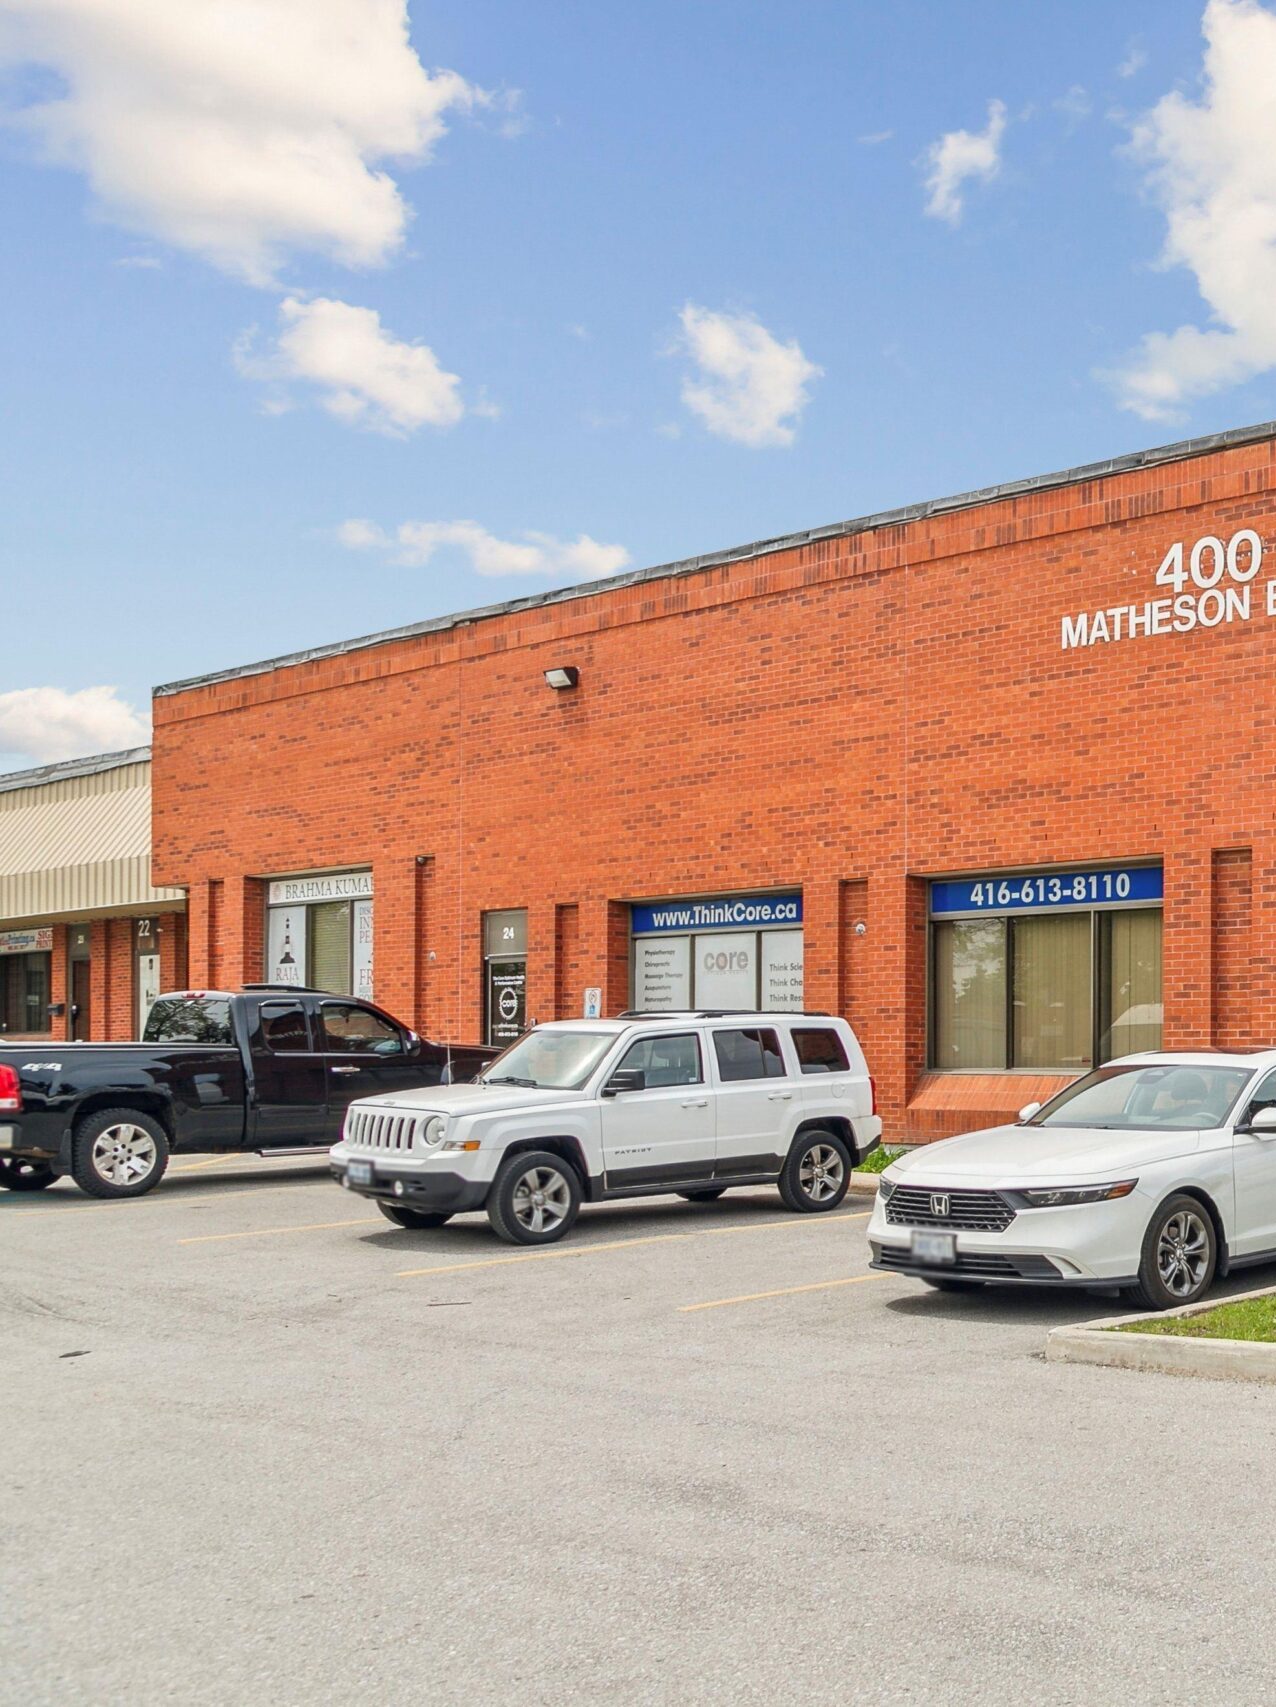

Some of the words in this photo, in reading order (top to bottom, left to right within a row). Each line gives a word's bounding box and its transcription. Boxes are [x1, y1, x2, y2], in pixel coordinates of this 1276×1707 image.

[1156, 529, 1262, 593] 400
[1061, 586, 1250, 649] MATHESON
[285, 882, 332, 899] BRAHMA
[970, 873, 1130, 906] 416-613-8110
[652, 903, 797, 927] www.ThinkCore.ca
[138, 920, 150, 936] 22
[503, 927, 514, 939] 24
[360, 930, 373, 943] PE
[704, 952, 749, 970] core
[769, 963, 788, 972] Think
[276, 967, 299, 982] RAJA
[769, 978, 788, 987] Think
[769, 994, 788, 1002] Think
[614, 1147, 653, 1155] PATRIOT
